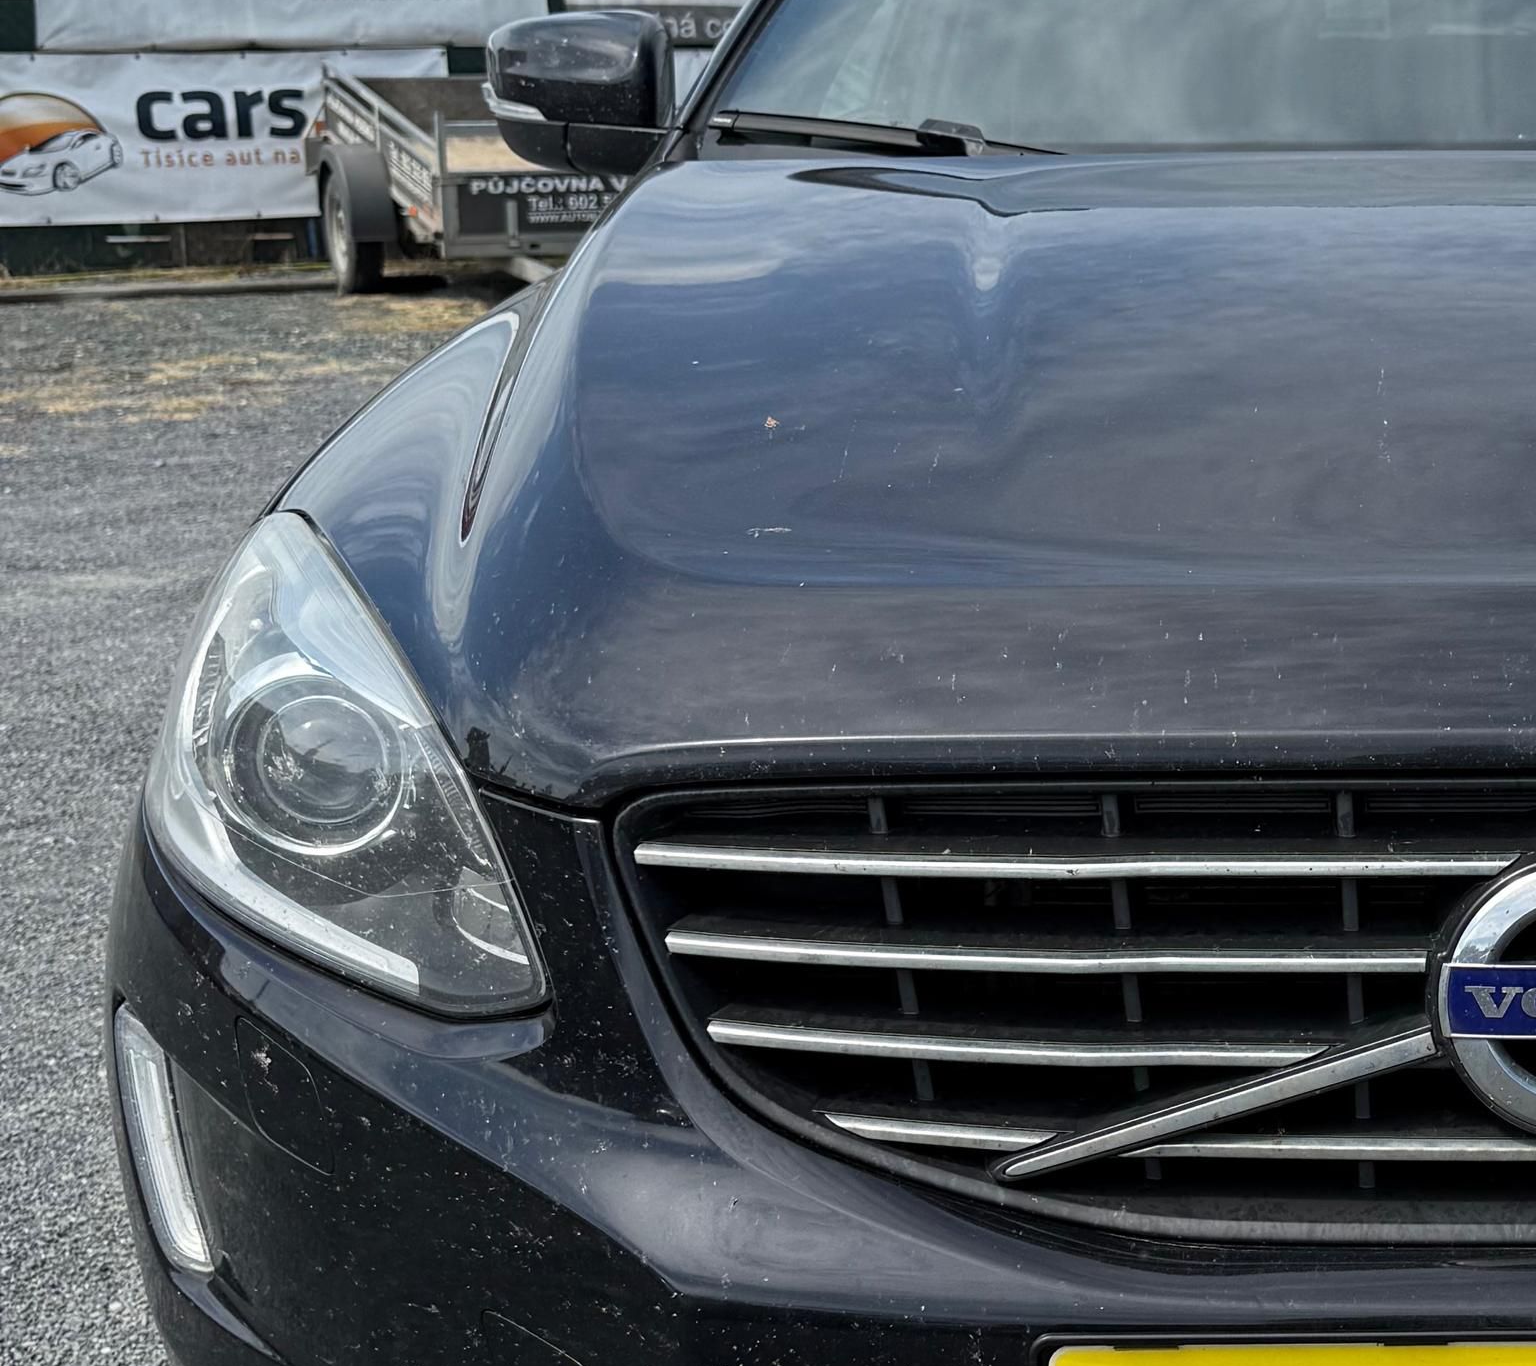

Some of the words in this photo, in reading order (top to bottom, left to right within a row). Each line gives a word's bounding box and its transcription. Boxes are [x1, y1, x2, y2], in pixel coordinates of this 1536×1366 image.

[136, 89, 307, 141] cars
[225, 147, 262, 166] aut
[274, 147, 301, 164] na
[567, 194, 598, 210] 602
